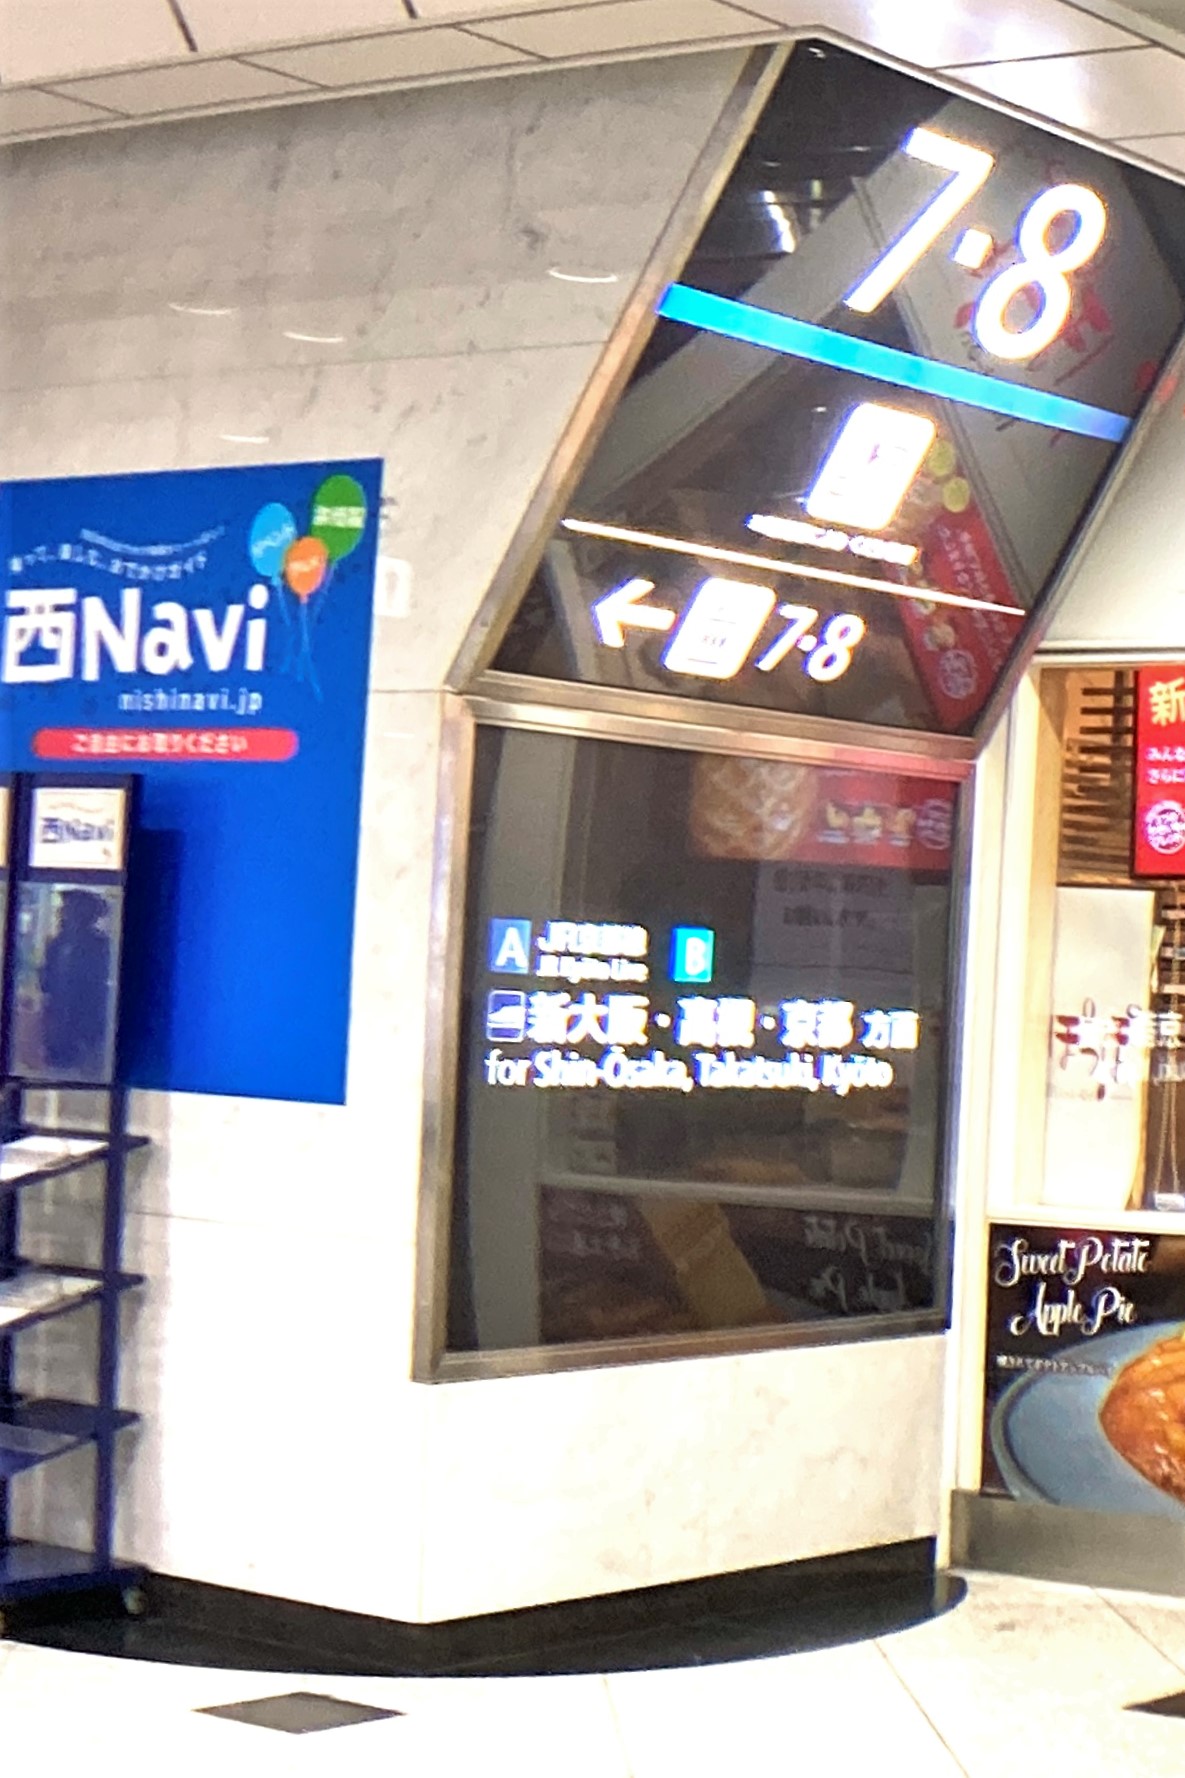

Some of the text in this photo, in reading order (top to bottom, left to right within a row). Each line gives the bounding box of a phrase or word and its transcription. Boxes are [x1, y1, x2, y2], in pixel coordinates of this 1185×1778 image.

[118, 687, 264, 716] nishinavi.jp
[485, 1049, 532, 1086] for
[994, 1237, 1076, 1288] Sweet
[1063, 1236, 1151, 1286] Potato
[1009, 1281, 1136, 1337] Apple Pie
